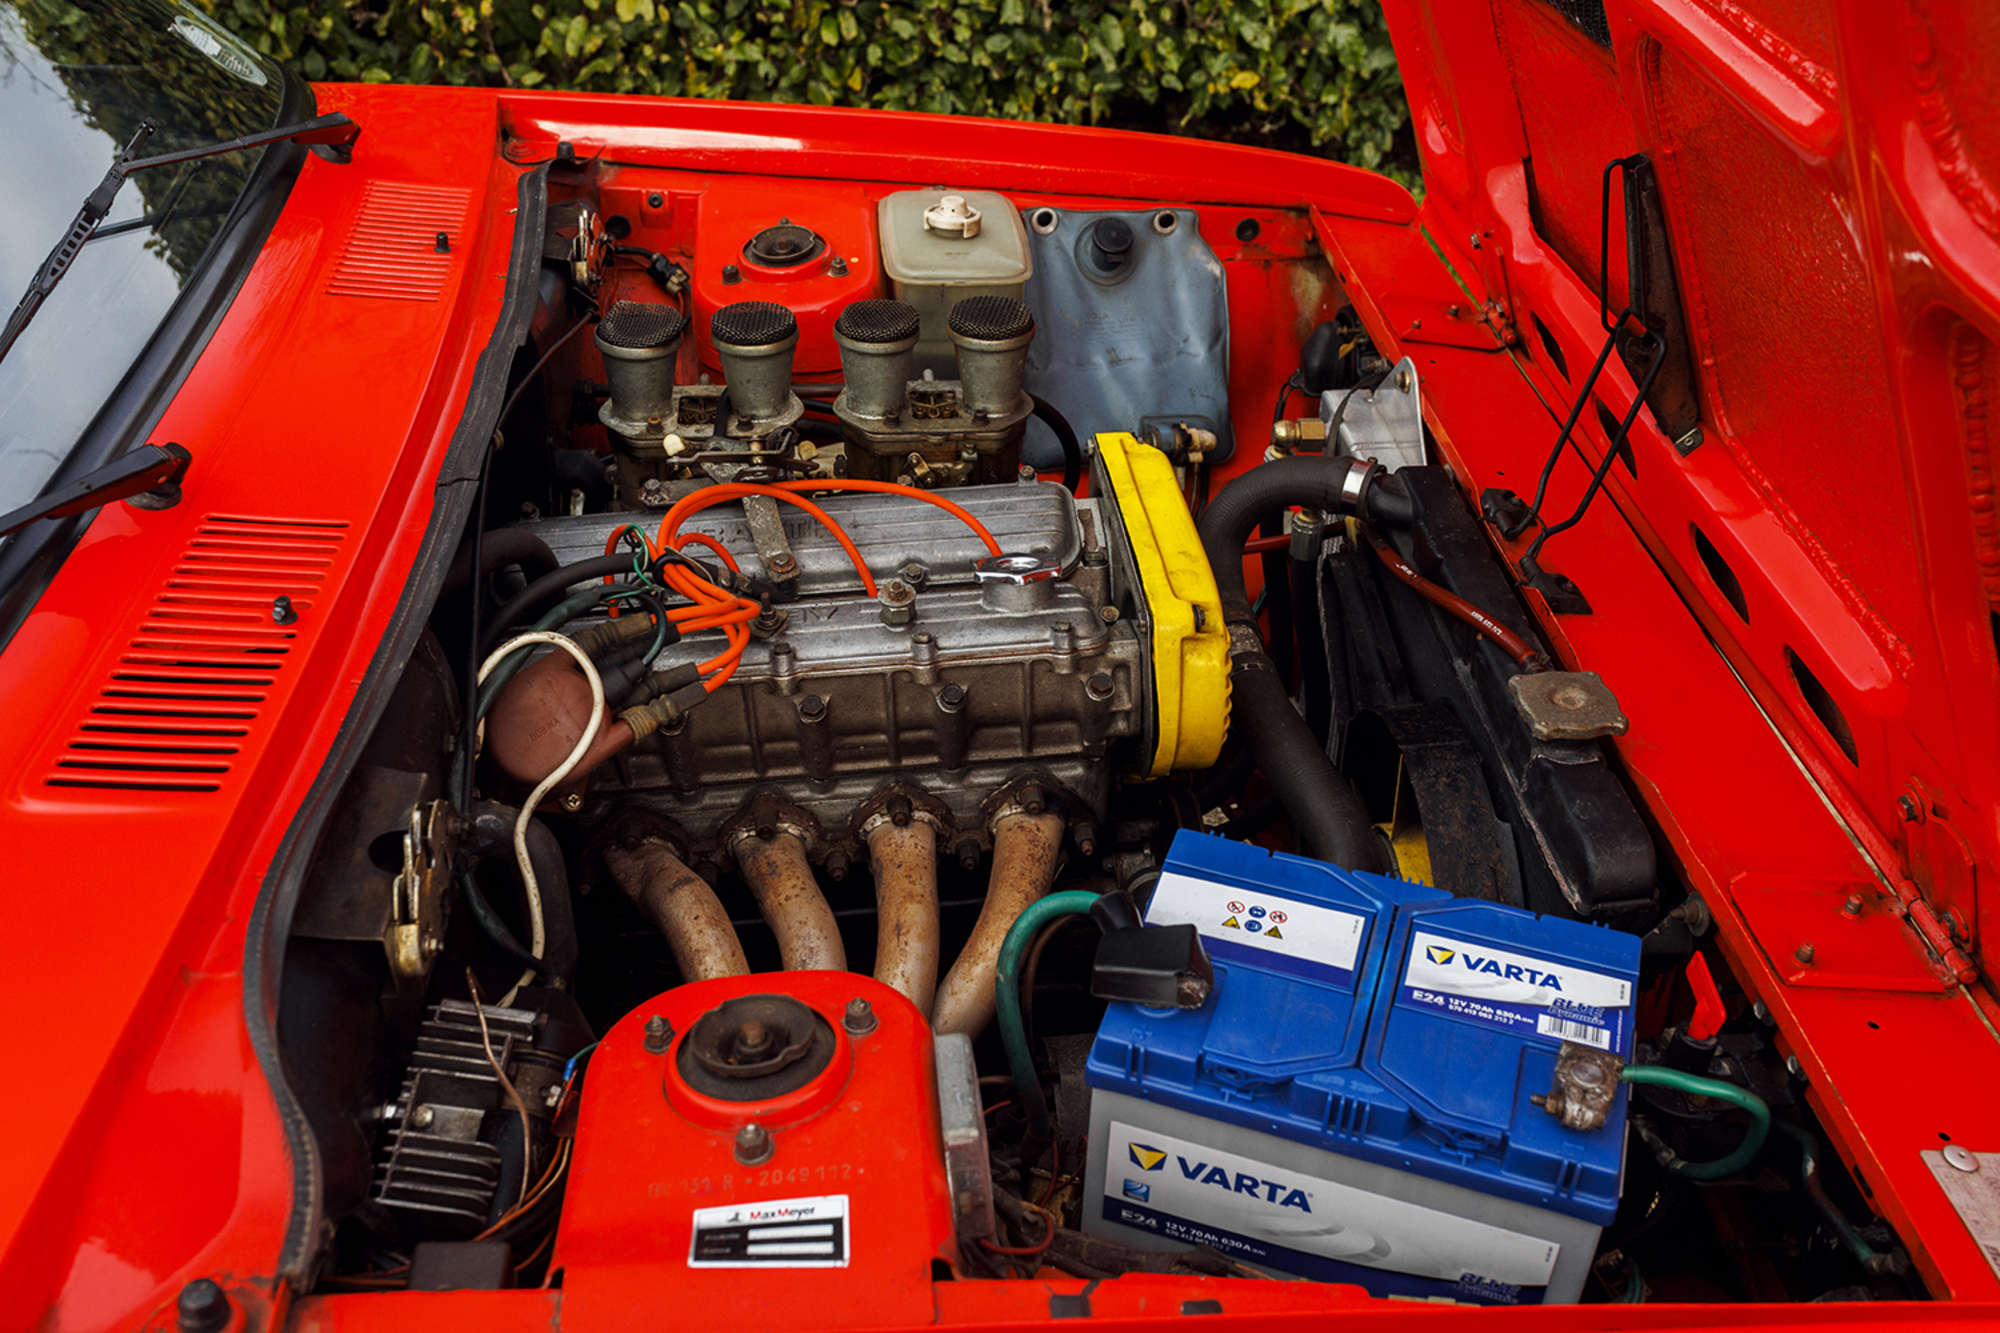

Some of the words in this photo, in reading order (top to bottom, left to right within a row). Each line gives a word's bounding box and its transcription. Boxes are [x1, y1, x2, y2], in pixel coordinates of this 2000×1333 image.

[1462, 953, 1563, 992] VARTA
[1412, 989, 1445, 1007] E24
[1449, 997, 1468, 1008] 12V
[1469, 1001, 1494, 1014] 70Ah
[1176, 1154, 1312, 1214] VARTA
[1120, 1208, 1158, 1229] E24
[1165, 1221, 1187, 1232] 12V
[1189, 1227, 1219, 1242] 70Ah
